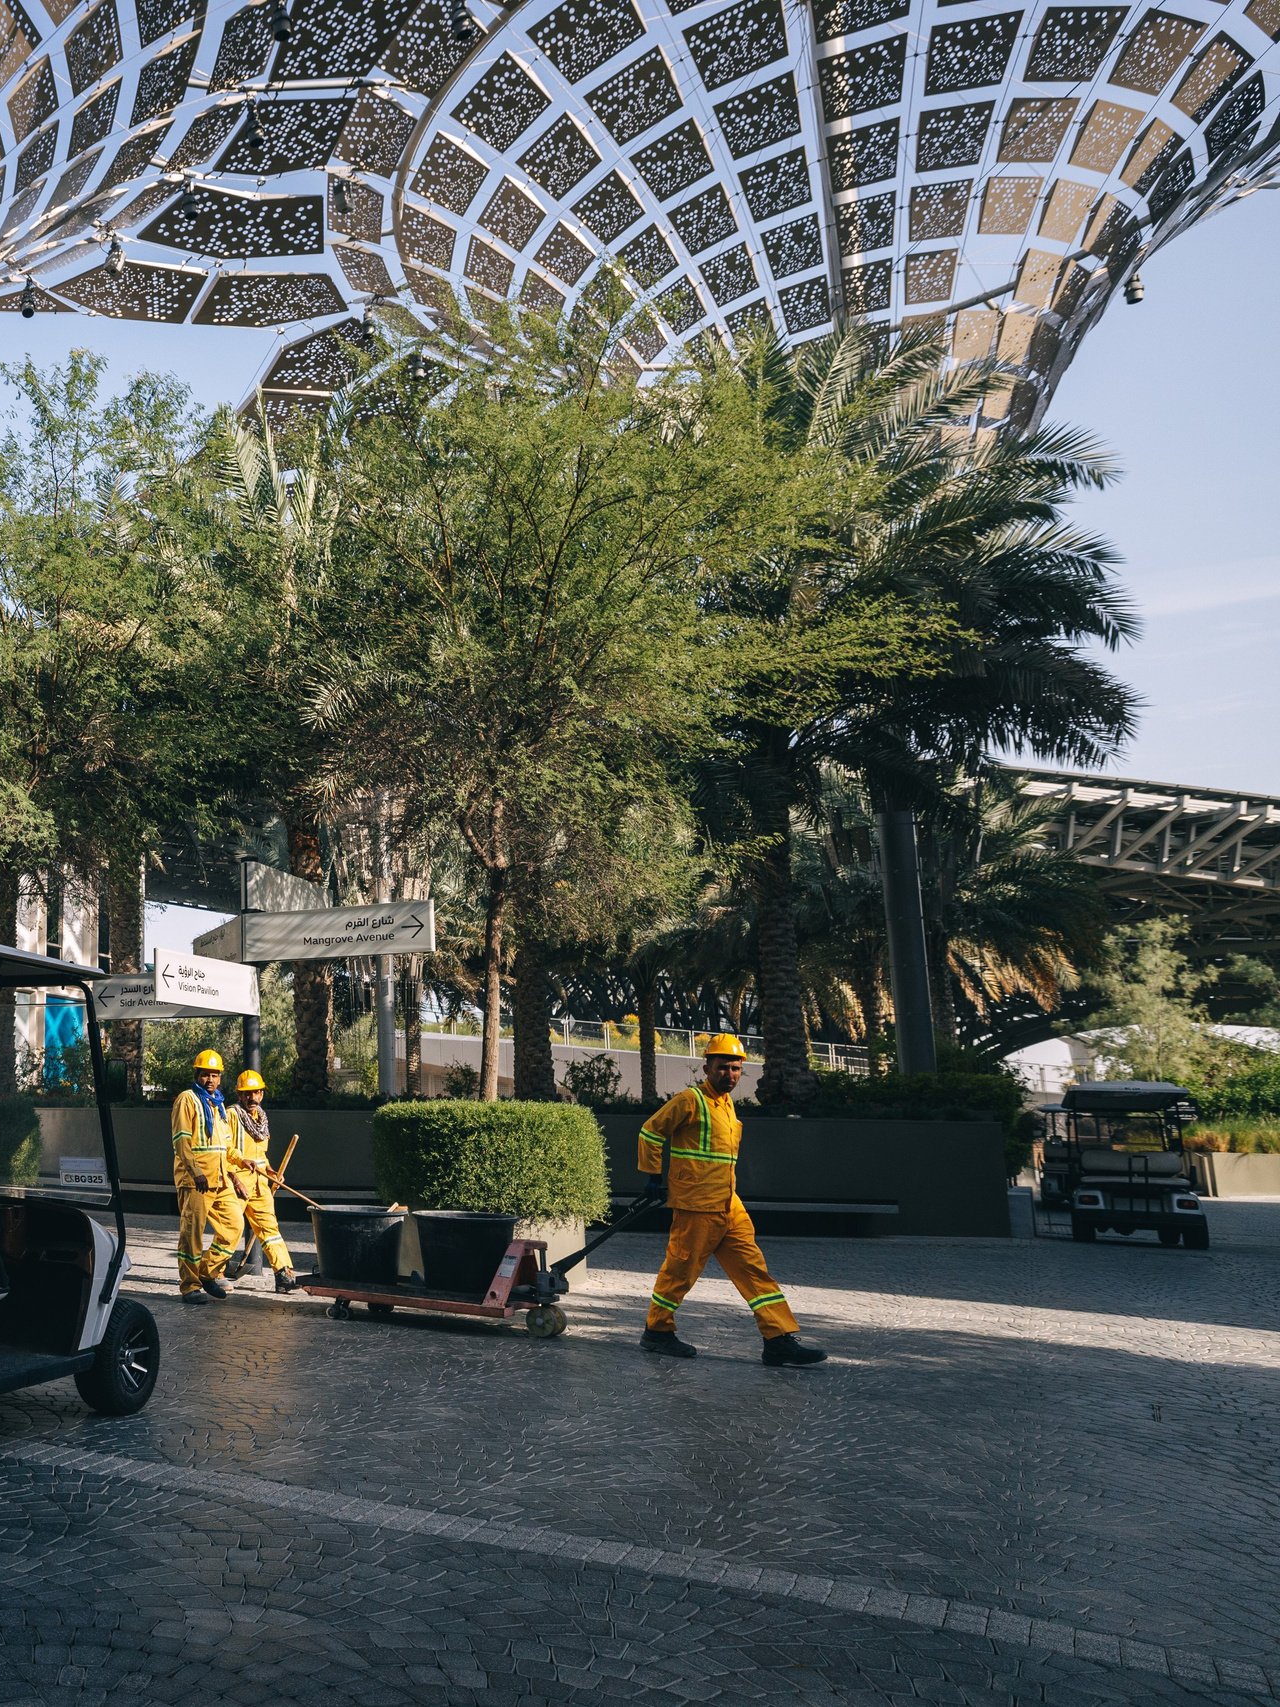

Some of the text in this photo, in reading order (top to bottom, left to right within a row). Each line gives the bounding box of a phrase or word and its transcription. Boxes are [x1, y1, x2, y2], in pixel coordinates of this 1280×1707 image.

[345, 915, 395, 931] شارع القرم
[303, 933, 395, 947] Mangrove Avenue
[194, 969, 206, 981] جناح
[120, 984, 154, 996] ارع السدر
[178, 982, 219, 996] Vision Pavilion
[120, 998, 136, 1007] Sidr
[74, 1175, 103, 1184] BG 325
